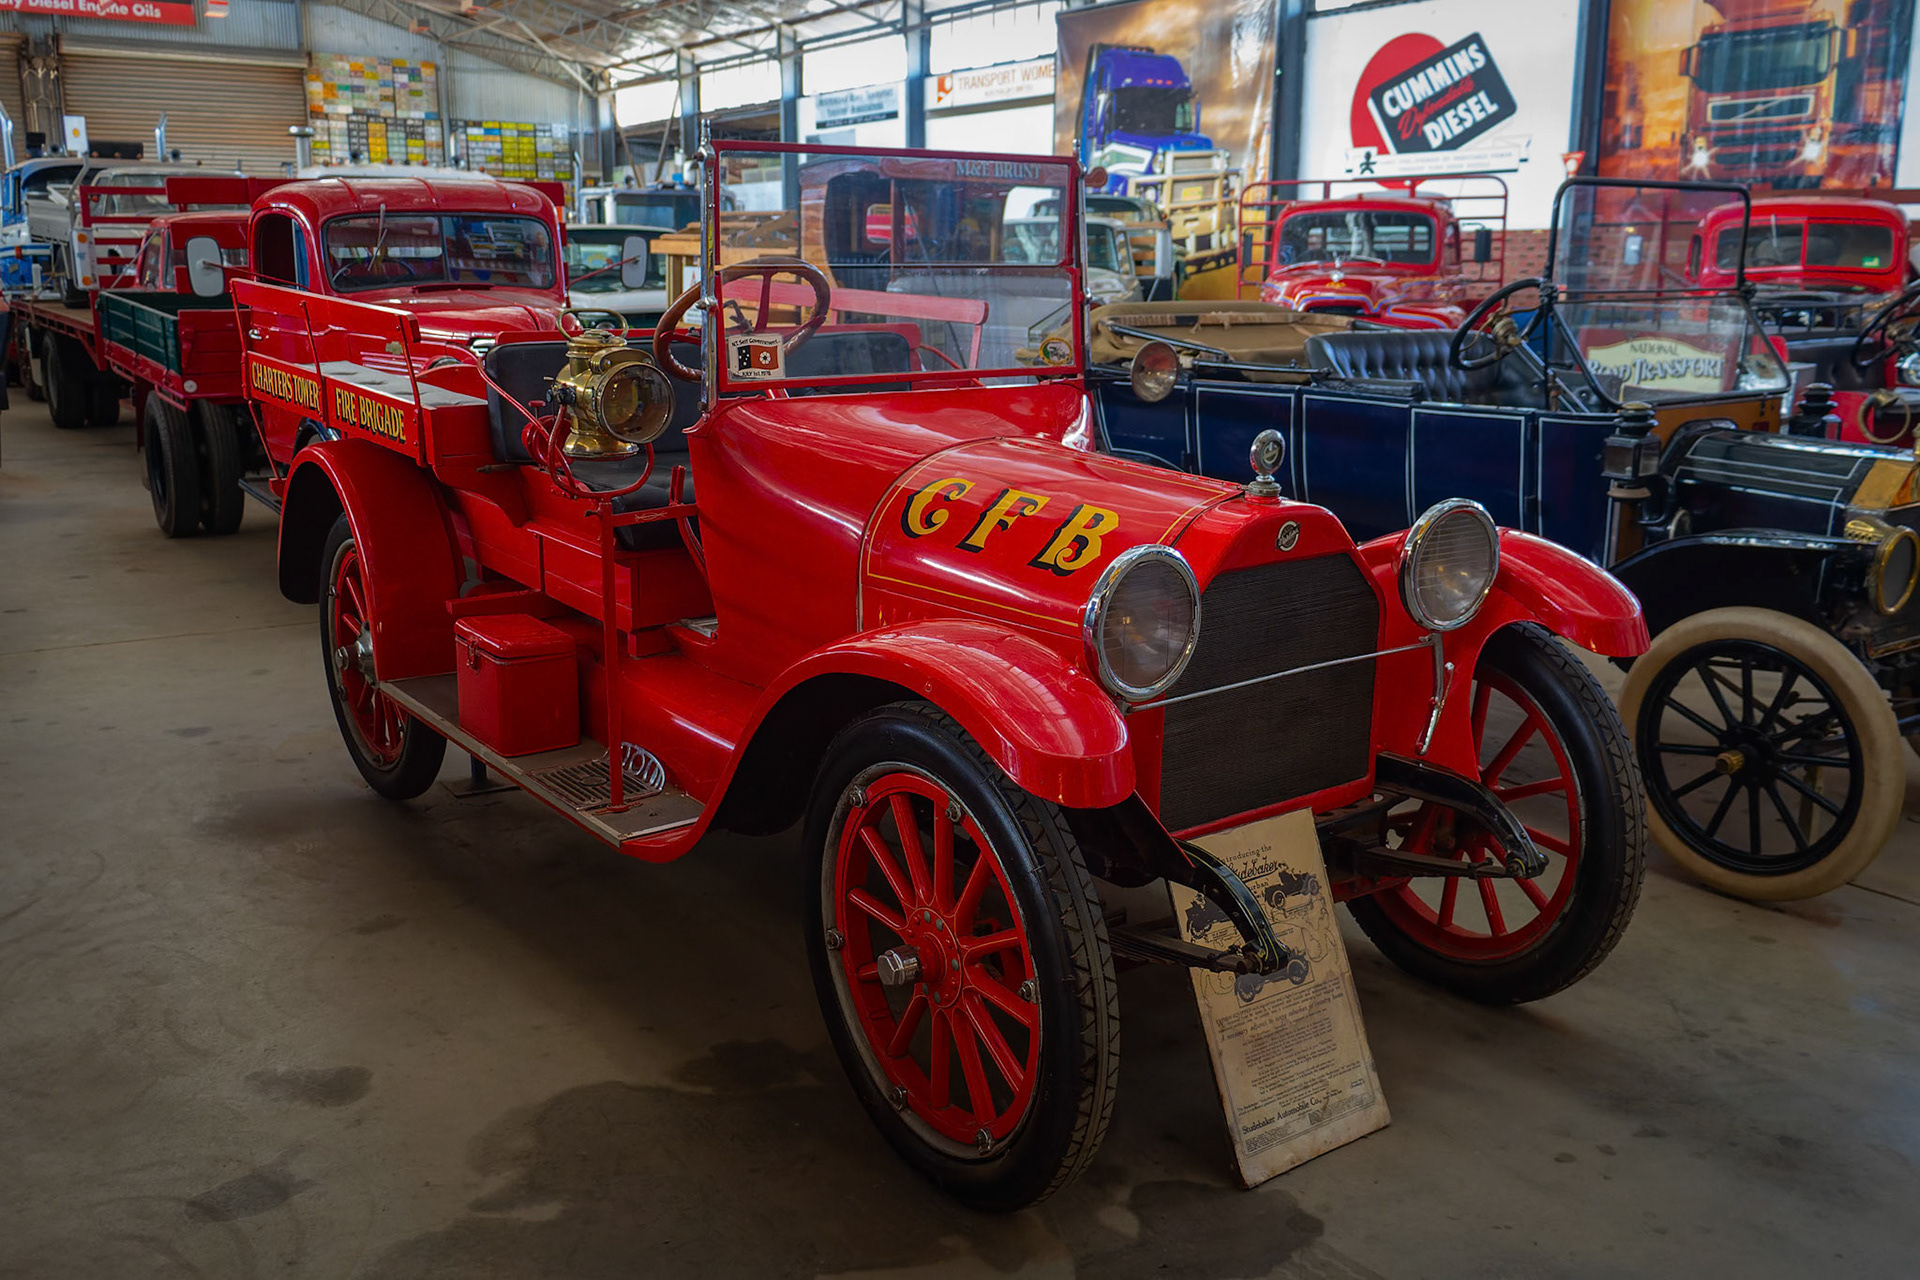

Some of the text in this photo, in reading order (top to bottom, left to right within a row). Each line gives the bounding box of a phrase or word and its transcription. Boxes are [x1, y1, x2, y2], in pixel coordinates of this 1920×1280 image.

[132, 3, 162, 18] Oils
[959, 64, 1053, 90] TRANSPORT WOME
[1383, 43, 1485, 117] CUMMINS
[1422, 89, 1499, 149] DIESEL
[1629, 343, 1679, 355] NATIONAL
[1632, 357, 1725, 385] TRANSPORT
[251, 361, 320, 415] CHARTERS TOWER
[335, 387, 407, 444] FIRE BRIGADE
[1261, 844, 1272, 853] the
[1242, 1114, 1276, 1134] Studebaker
[1277, 1101, 1309, 1120] Automobile
